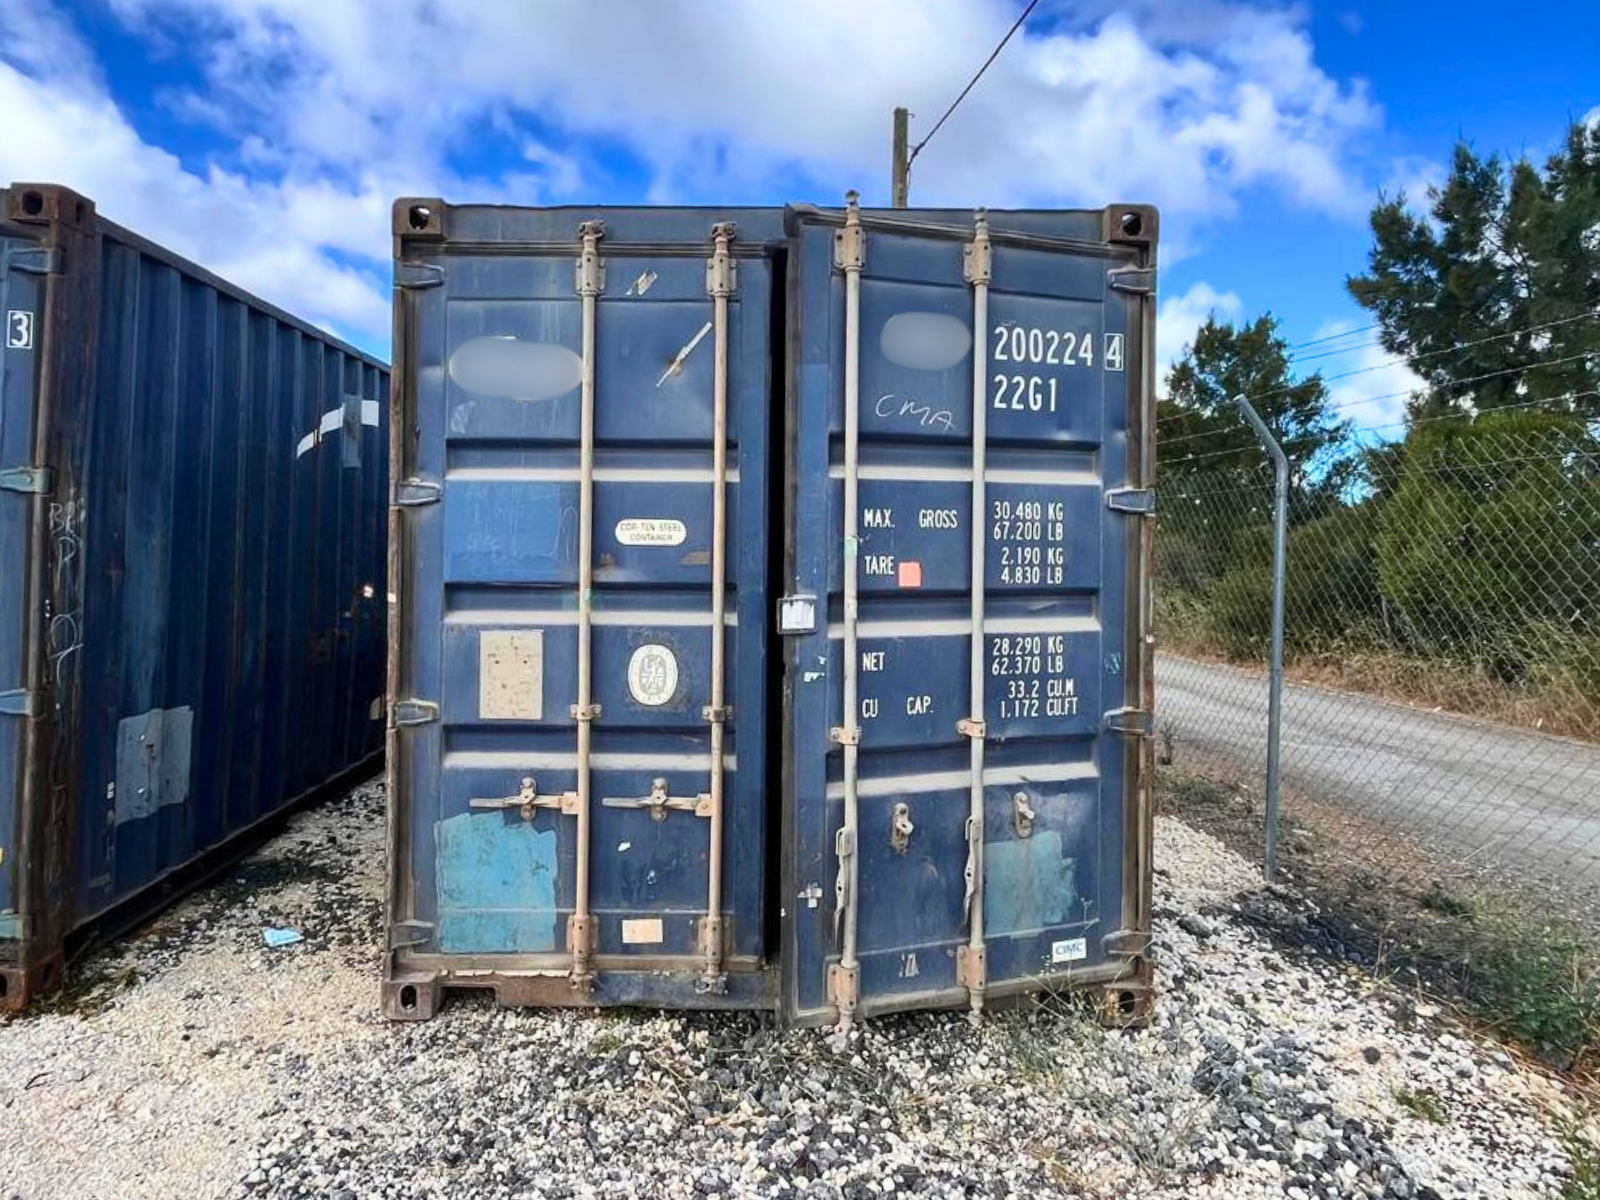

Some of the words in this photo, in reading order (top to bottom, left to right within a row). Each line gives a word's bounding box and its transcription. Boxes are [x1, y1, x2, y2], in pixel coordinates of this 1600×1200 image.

[10, 313, 29, 347] 3
[994, 326, 1094, 367] 200224
[1106, 335, 1122, 369] 4
[993, 374, 1057, 412] 22G1
[875, 394, 956, 431] CMA
[864, 508, 896, 529] MAX.
[919, 509, 958, 529] GROSS
[1047, 502, 1064, 520] KG
[1047, 522, 1063, 541] LB
[864, 555, 895, 575] TARE
[1047, 547, 1064, 565] KG
[1046, 566, 1063, 585] LB
[1047, 635, 1064, 654] KG
[862, 652, 886, 672] NET
[1047, 655, 1063, 674] LB
[1007, 680, 1040, 699] 33.2
[861, 698, 878, 719] CU
[906, 695, 934, 715] CAP.
[1046, 696, 1078, 717] CU.FT
